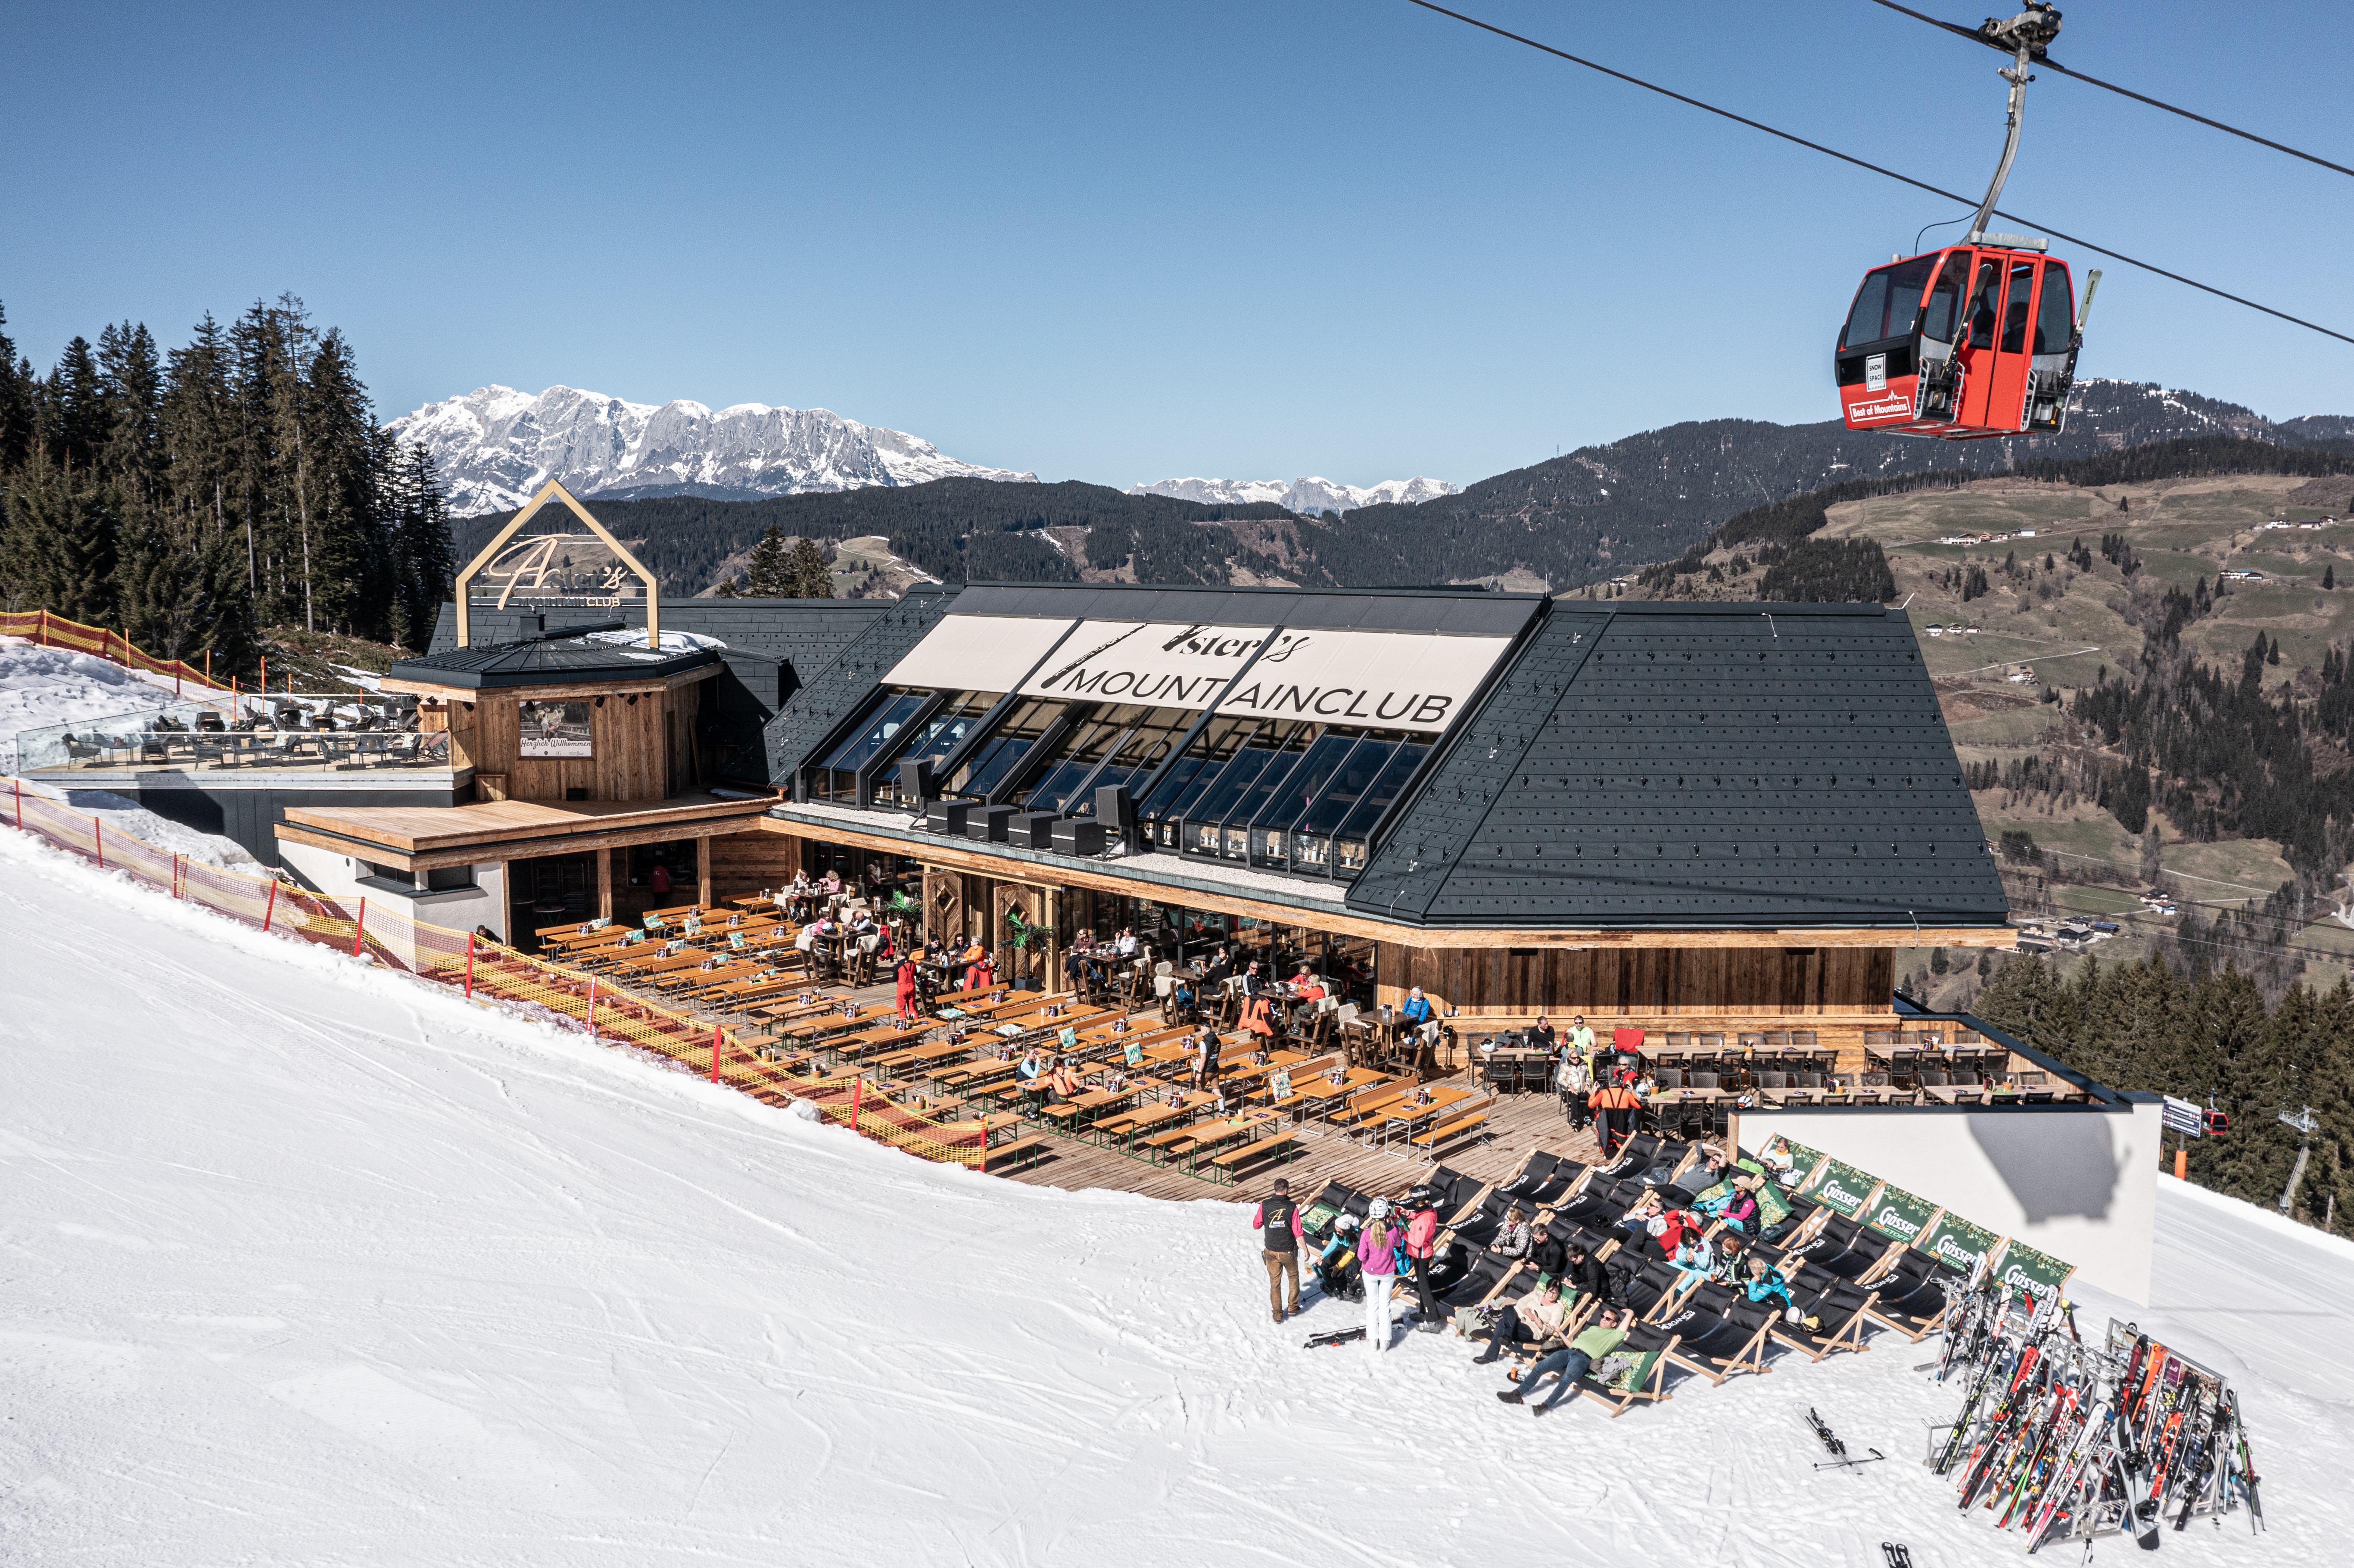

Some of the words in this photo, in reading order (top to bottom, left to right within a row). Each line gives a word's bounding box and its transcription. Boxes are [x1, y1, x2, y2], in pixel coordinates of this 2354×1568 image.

[2086, 280, 2095, 305] SALOMON
[1853, 408, 1865, 417] Best
[1866, 405, 1873, 415] of
[1875, 401, 1907, 414] Mountains
[489, 533, 627, 610] Aster's
[1062, 669, 1453, 723] MOUNTAINCLUB
[521, 739, 549, 750] Herzlich
[551, 739, 591, 747] Willkommen
[1823, 1179, 1863, 1207] Gösser
[1557, 1195, 1586, 1211] ORGANICS
[1451, 1213, 1482, 1229] ORGANICS
[1879, 1206, 1921, 1235] Gösser
[1792, 1238, 1823, 1256] ORGANICS
[1864, 1273, 1897, 1290] ORGANICS
[1660, 1310, 1693, 1330] ORGANICS
